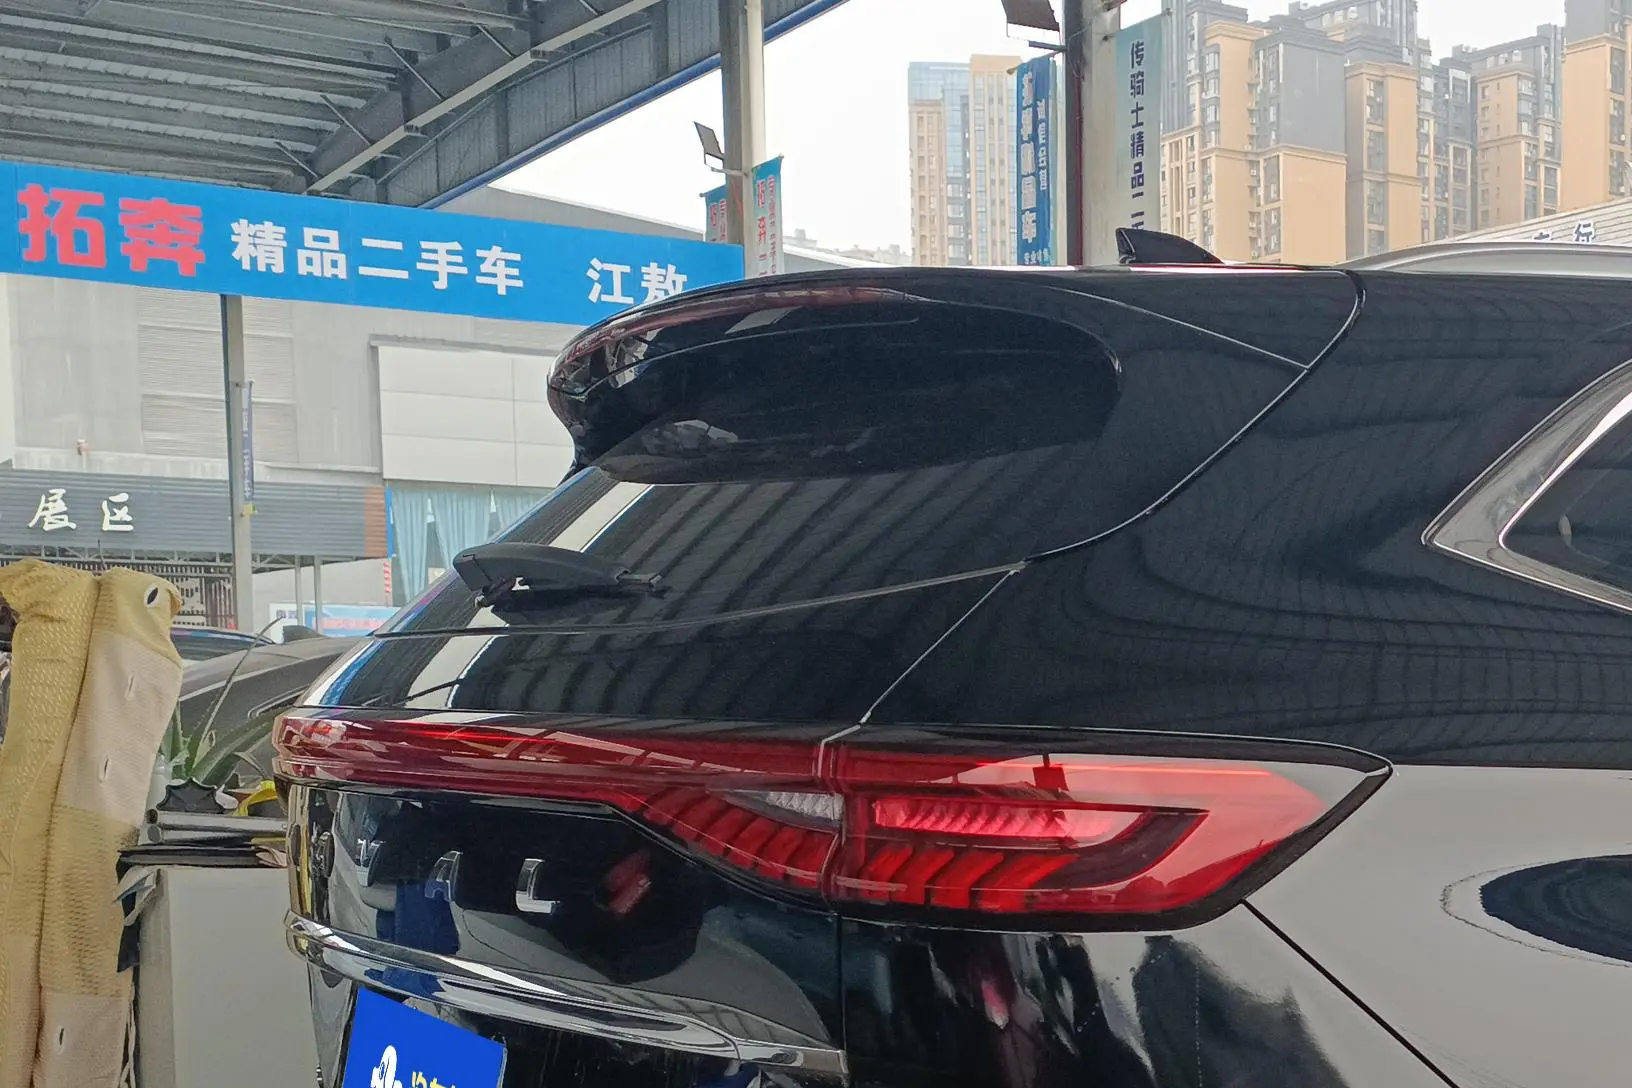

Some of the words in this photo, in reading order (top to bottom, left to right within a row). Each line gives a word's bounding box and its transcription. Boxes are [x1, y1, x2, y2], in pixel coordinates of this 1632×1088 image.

[17, 183, 206, 276] 拓奔
[231, 219, 524, 296] 精品二手车
[27, 488, 134, 532] 展区
